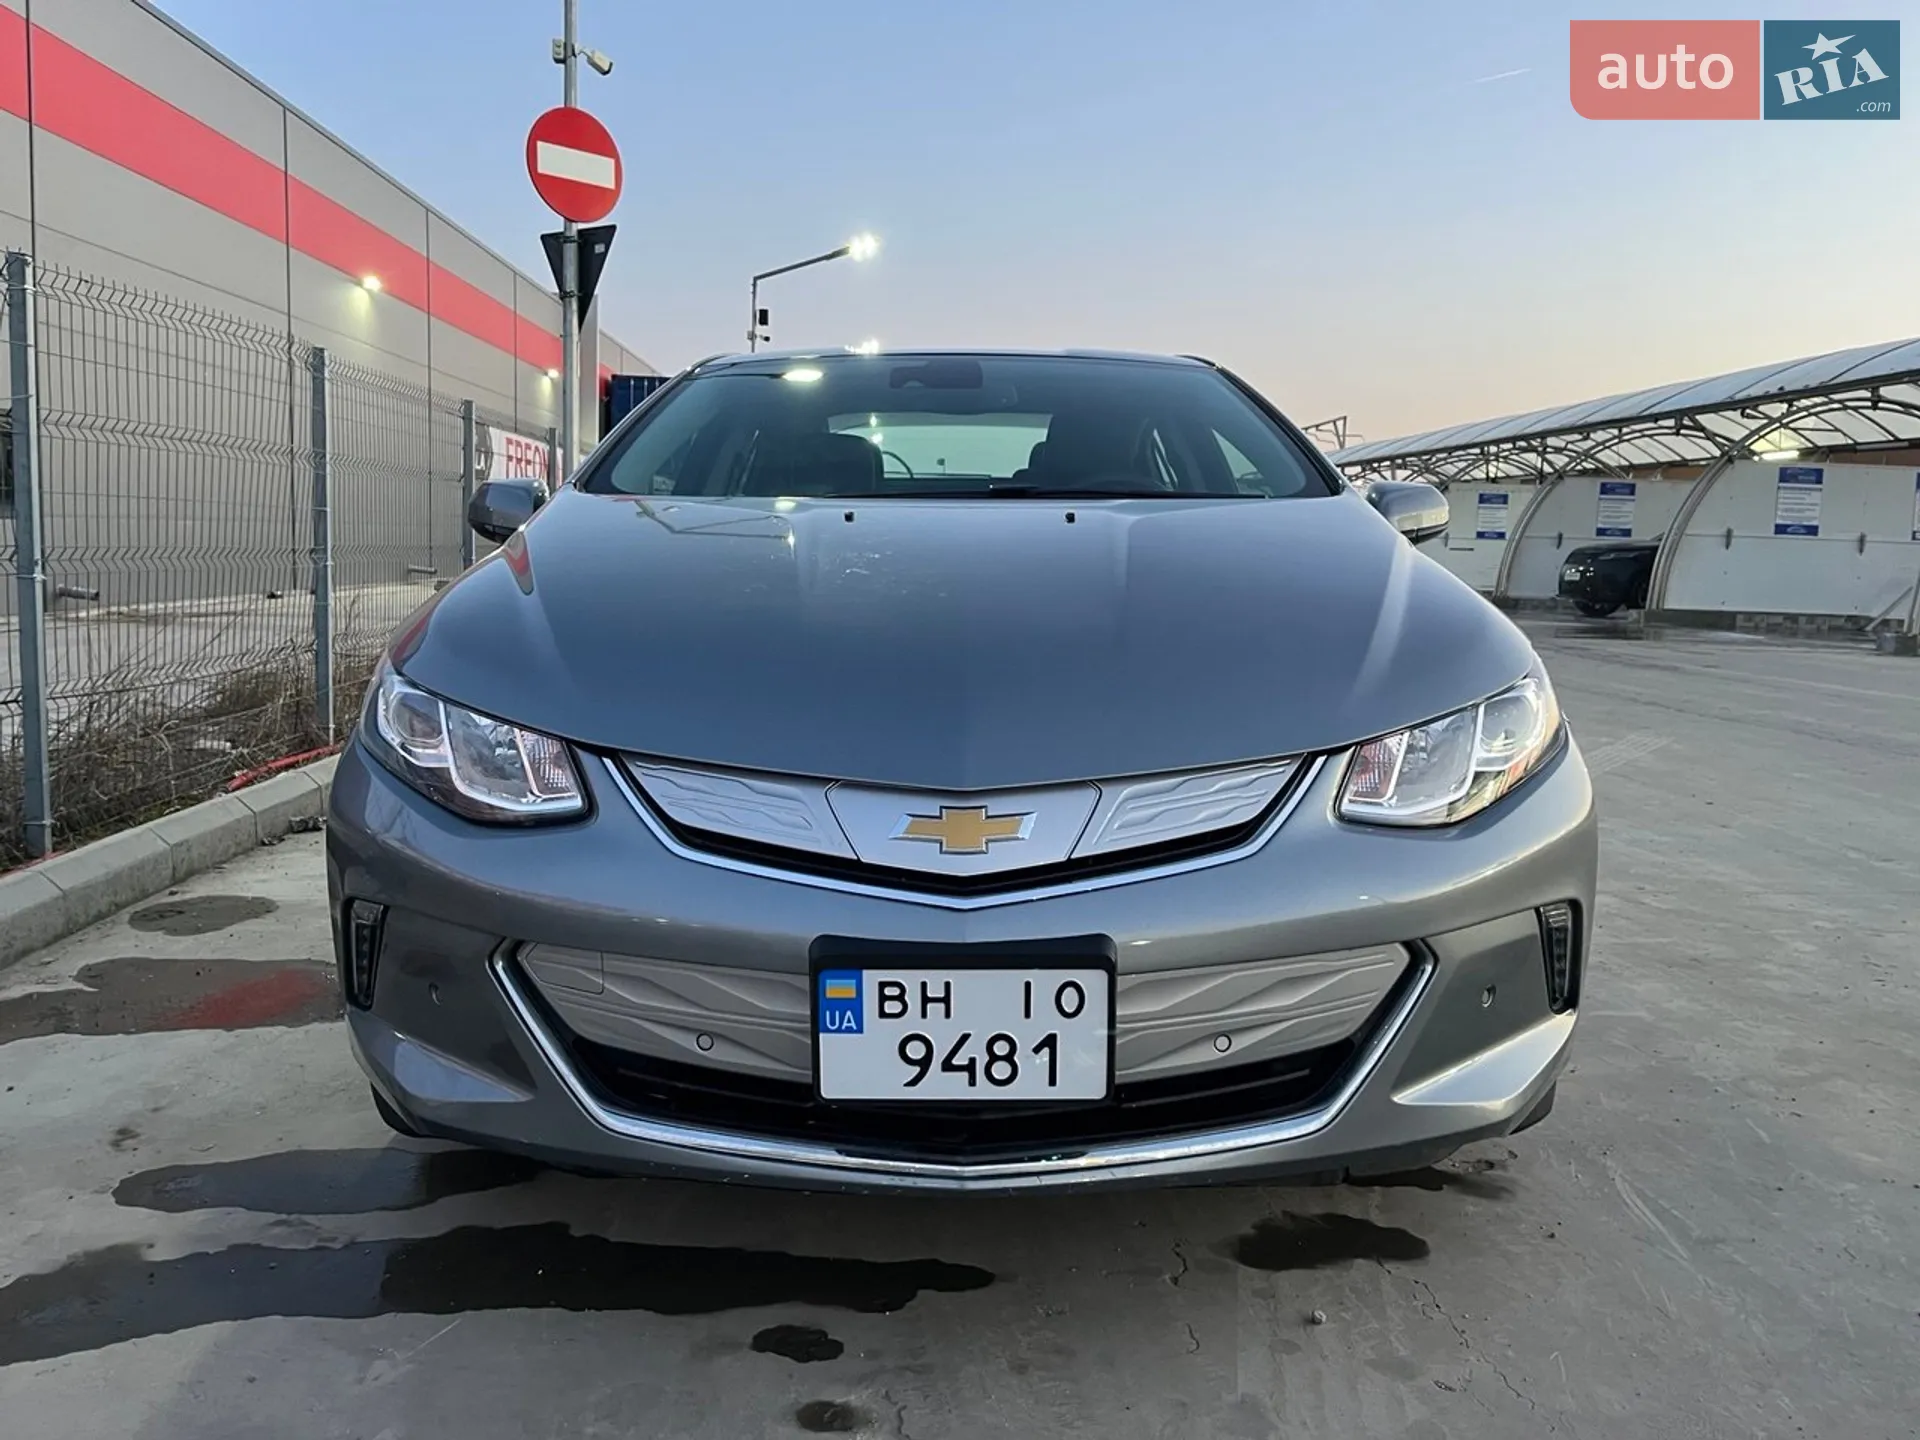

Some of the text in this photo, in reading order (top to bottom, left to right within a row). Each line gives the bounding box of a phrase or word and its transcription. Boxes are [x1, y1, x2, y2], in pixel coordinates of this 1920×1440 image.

[877, 980, 952, 1019] BH
[826, 1010, 857, 1030] UA
[898, 1032, 1059, 1088] 9481
